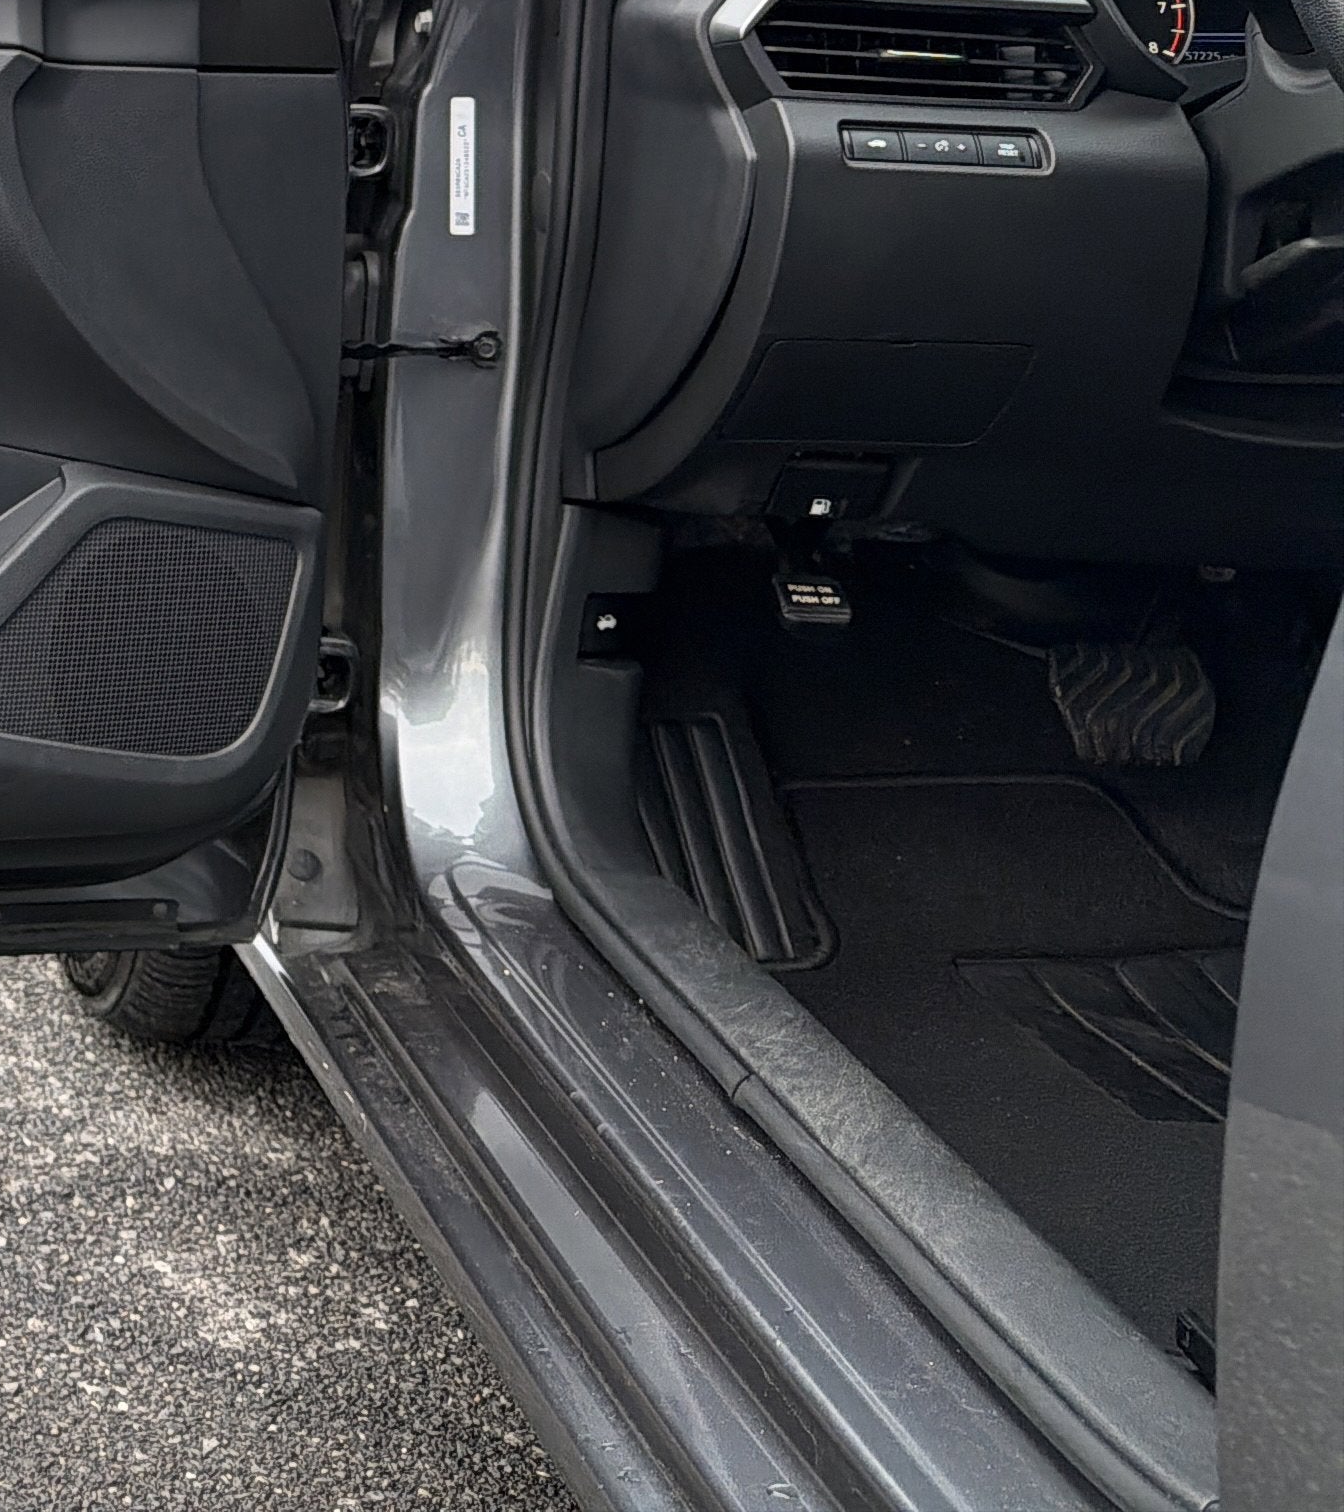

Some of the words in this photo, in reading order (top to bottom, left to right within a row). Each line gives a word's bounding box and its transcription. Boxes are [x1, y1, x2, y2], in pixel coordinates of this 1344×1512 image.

[1157, 1, 1166, 14] 7
[1148, 41, 1159, 54] 8
[791, 594, 820, 604] PUSH
[820, 595, 841, 605] OFF
